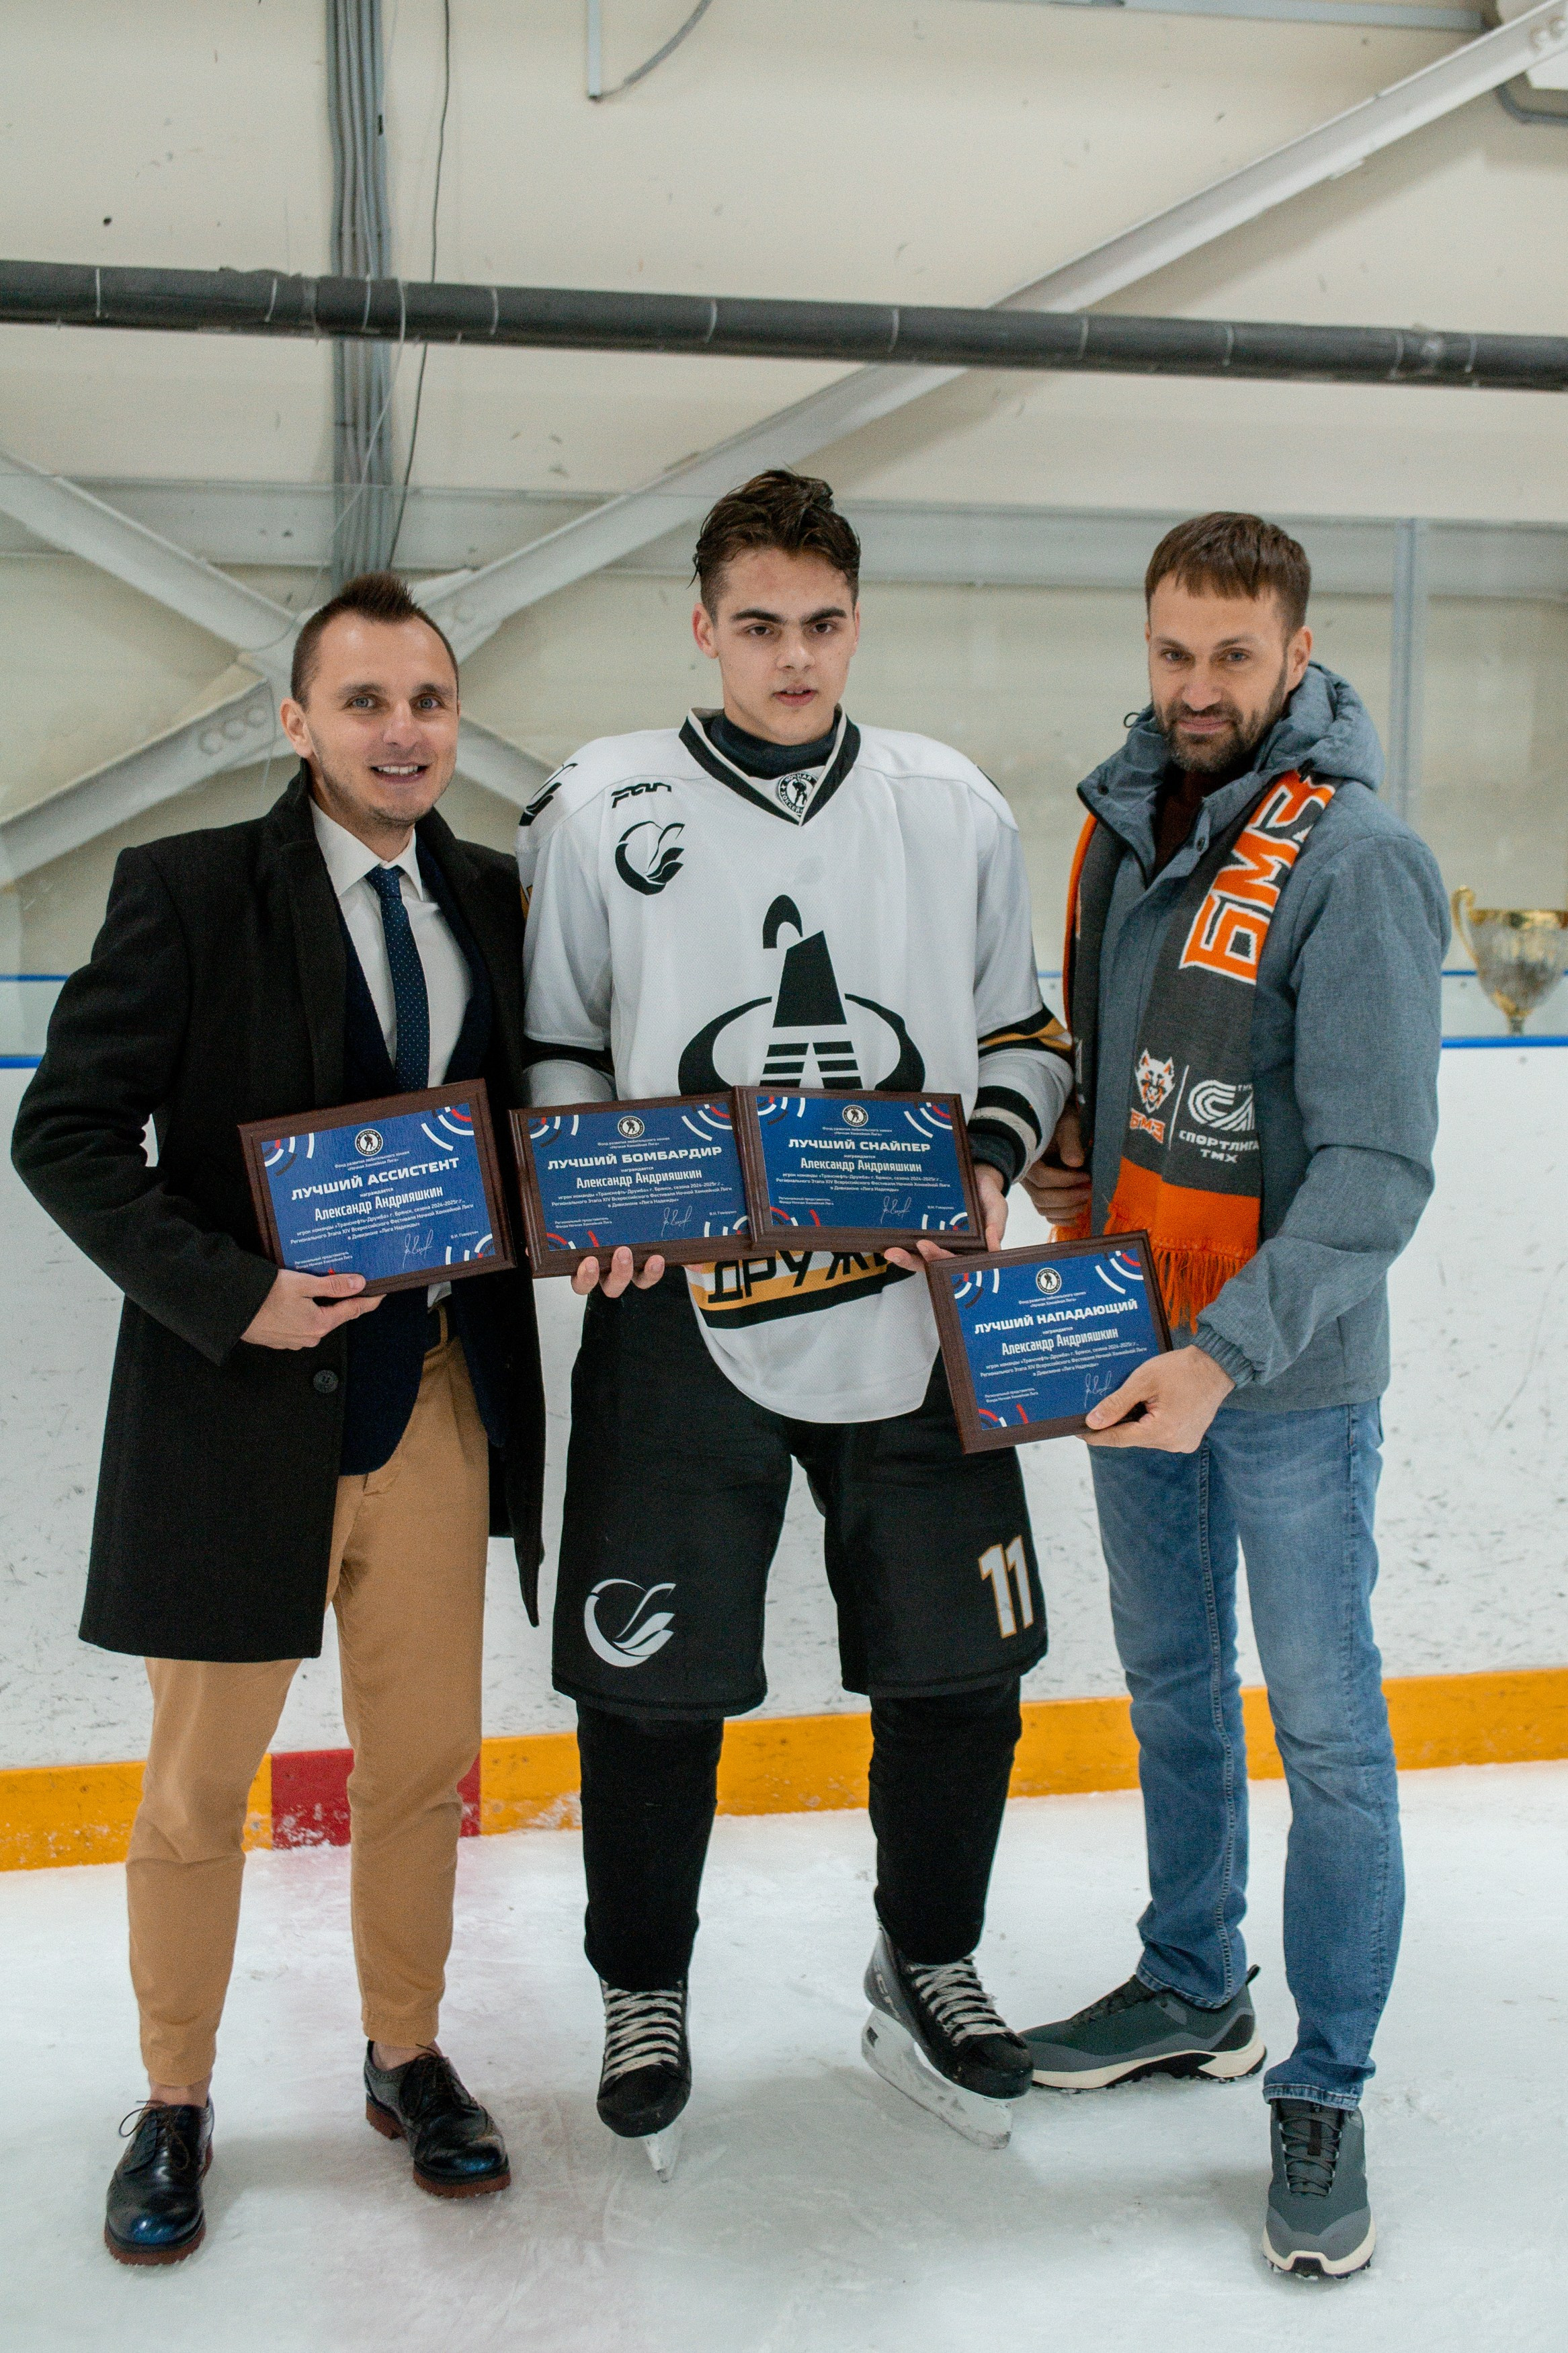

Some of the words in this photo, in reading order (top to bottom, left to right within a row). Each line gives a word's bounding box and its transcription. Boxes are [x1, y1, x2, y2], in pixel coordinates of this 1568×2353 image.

[1129, 1107, 1165, 1144] БМЗ
[788, 1139, 856, 1150] ЛУЧШИЙ
[860, 1141, 930, 1152] СНАЙПЕР
[1178, 1129, 1260, 1152] СПОРТЛИГА
[547, 1154, 617, 1170] ЛУЧШИЙ
[622, 1146, 722, 1163] БОМБАРДИР
[800, 1158, 855, 1172] Александр
[858, 1159, 922, 1173] Андрияшкин
[1200, 1148, 1239, 1164] ТМХ
[291, 1175, 363, 1201] ЛУЧШИЙ
[367, 1158, 460, 1185] АССИСТЕНТ
[360, 1187, 394, 1197] награждается
[576, 1176, 632, 1189] Александр
[635, 1170, 702, 1185] Андрияшкин
[315, 1201, 372, 1222] Александр
[375, 1187, 443, 1209] Андрияшкин
[290, 1234, 327, 1244] Регионального
[351, 1221, 390, 1232] Всероссийского
[390, 1215, 416, 1224] Фестиваля
[352, 1230, 378, 1240] Дивизионе
[708, 1250, 887, 1303] ДРУЖ
[974, 1314, 1034, 1334] ЛУЧШИЙ
[1036, 1299, 1138, 1324] НАПАДАЮЩИЙ
[1002, 1339, 1055, 1355] Александр
[1057, 1328, 1118, 1347] Андрияшкин
[979, 1535, 1034, 1639] 11
